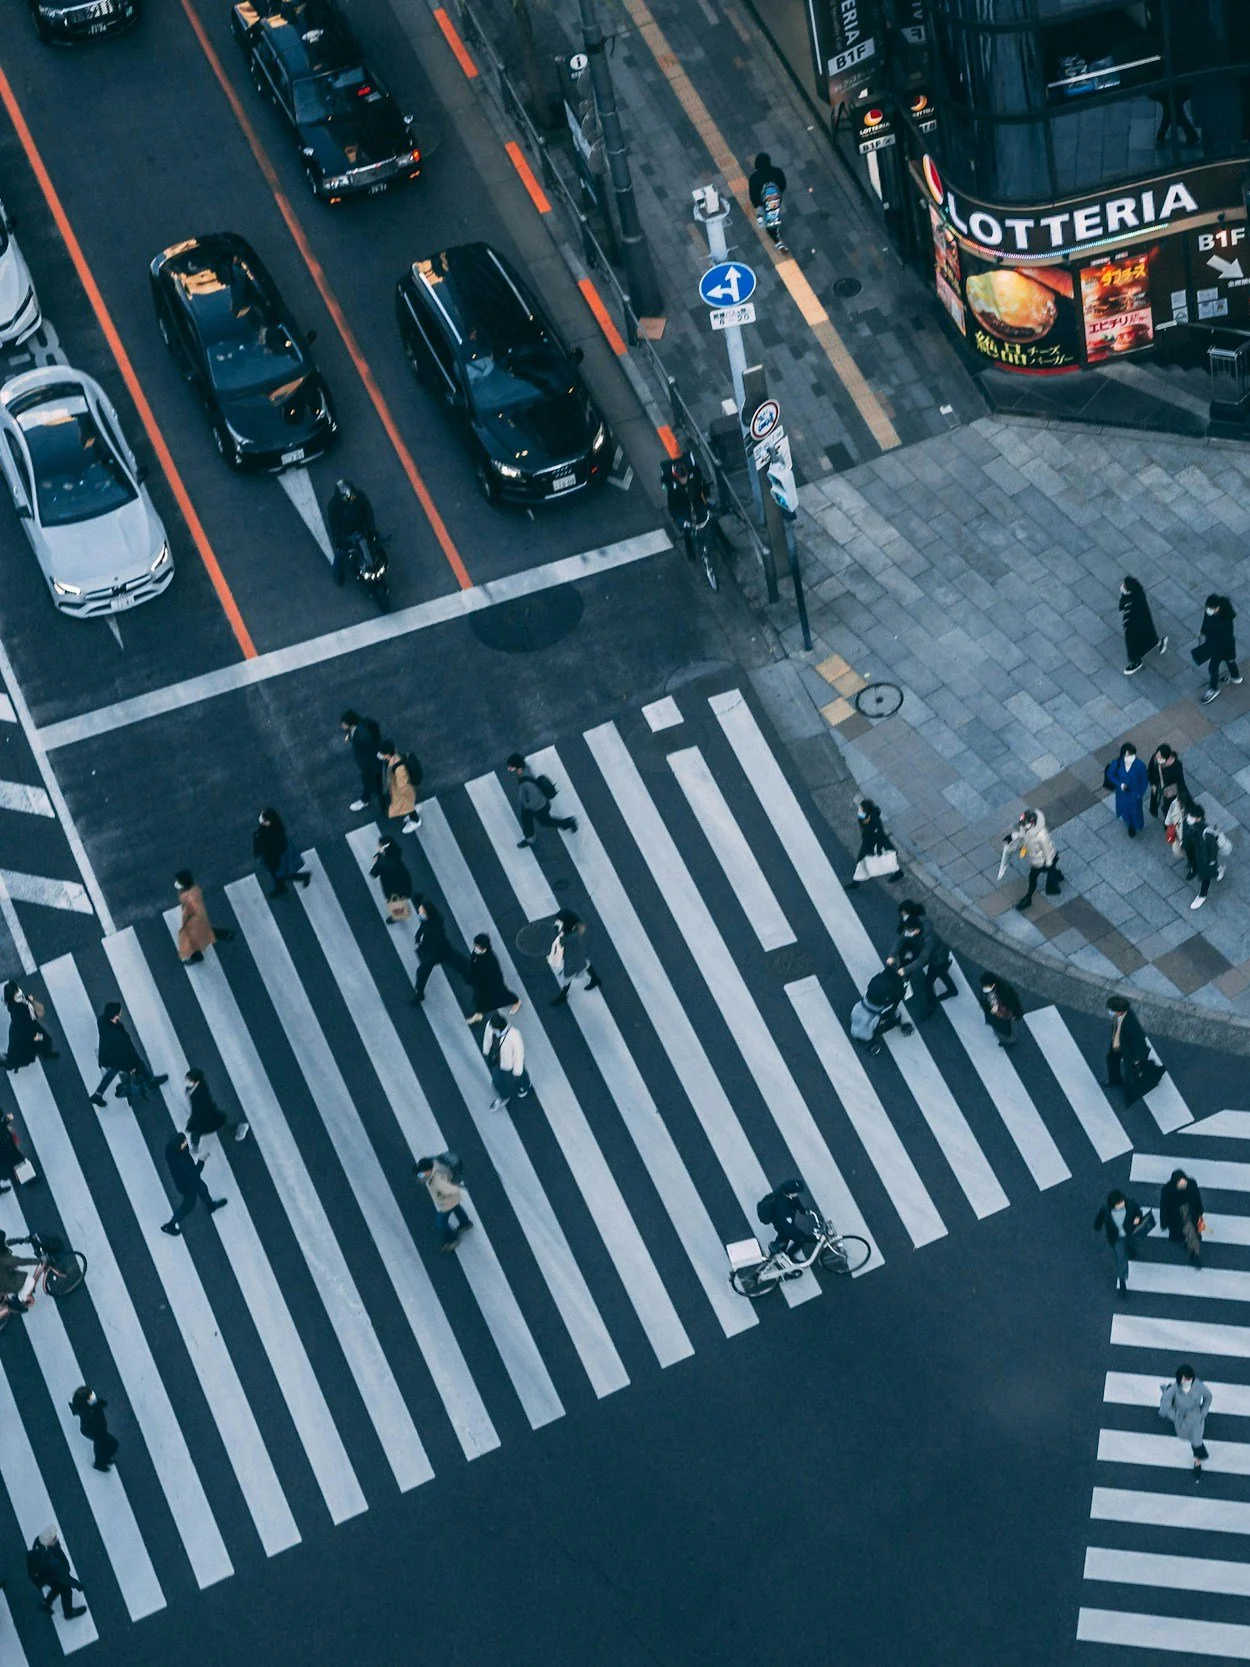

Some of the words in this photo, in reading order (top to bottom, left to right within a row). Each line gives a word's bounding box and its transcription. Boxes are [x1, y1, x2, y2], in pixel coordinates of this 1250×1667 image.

[836, 44, 866, 71] B1F
[859, 121, 890, 137] LOTTERIA
[947, 182, 1199, 250] LOTTERIA
[1199, 227, 1246, 252] B1F
[975, 329, 1027, 366] 絶品
